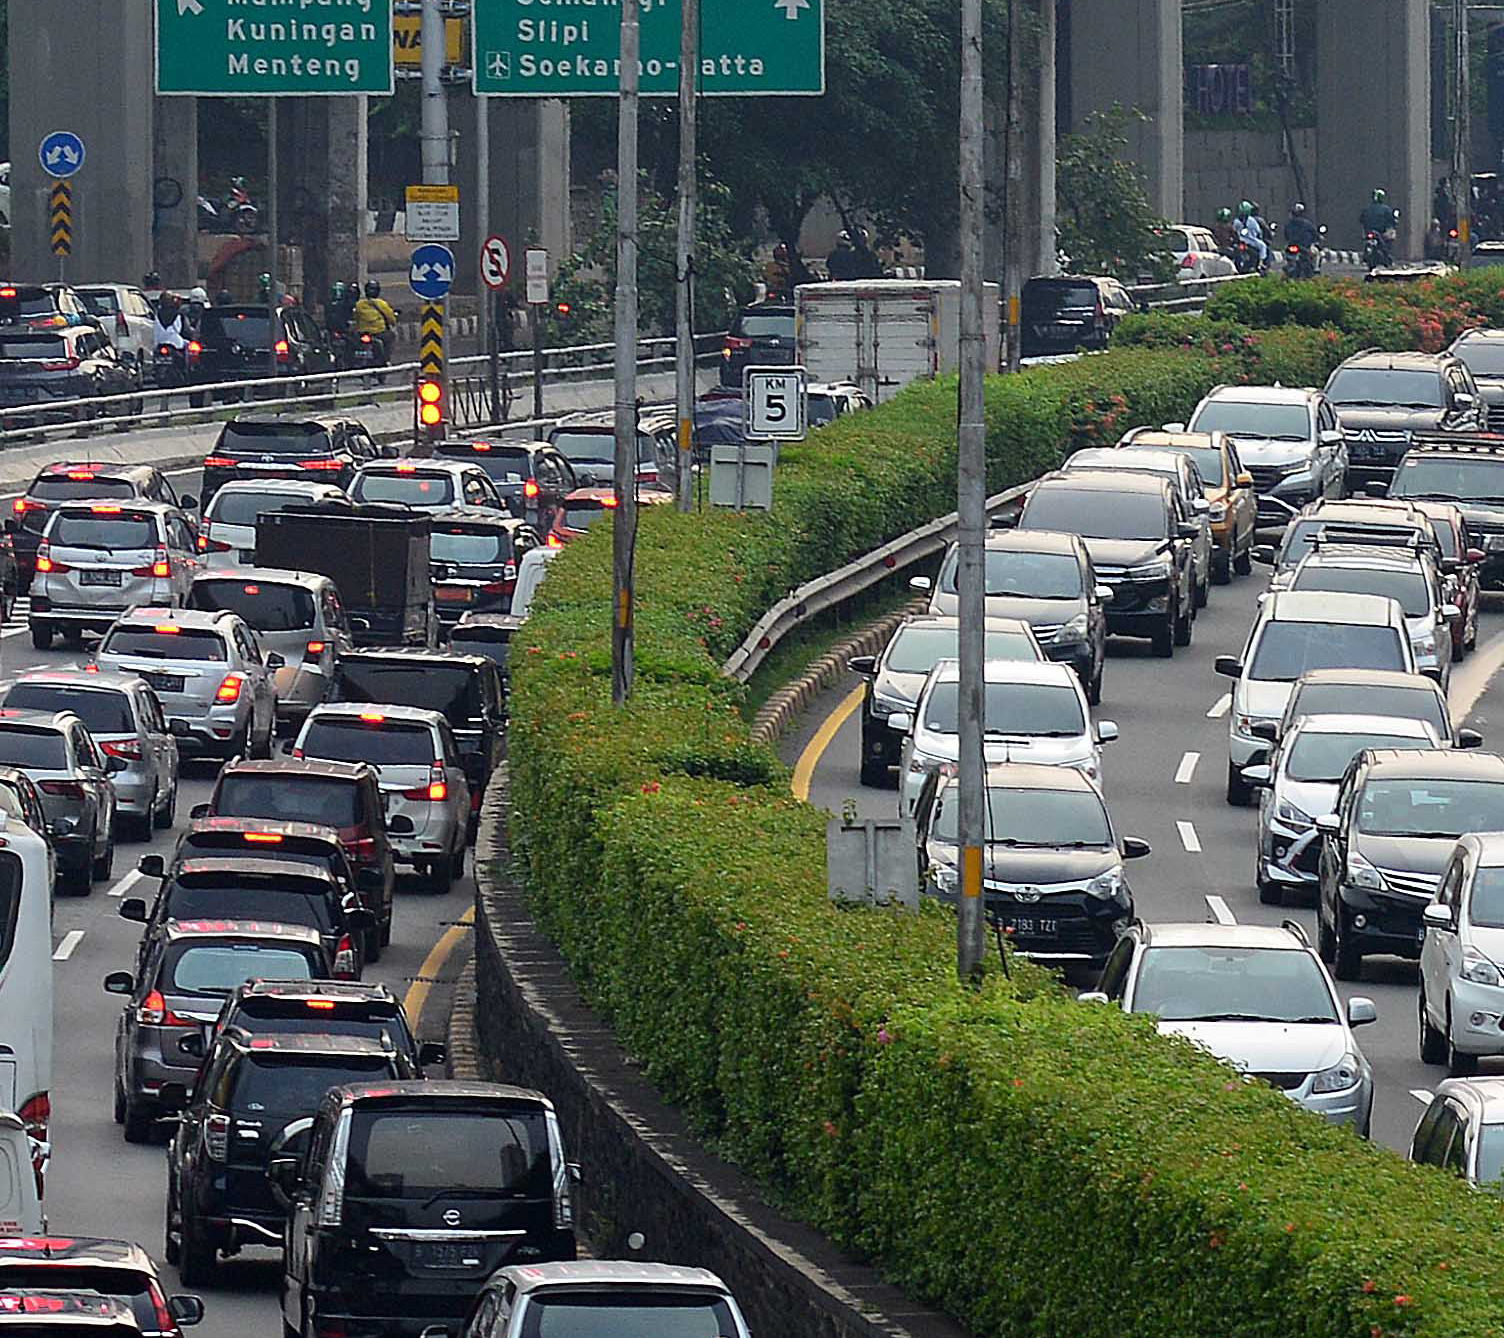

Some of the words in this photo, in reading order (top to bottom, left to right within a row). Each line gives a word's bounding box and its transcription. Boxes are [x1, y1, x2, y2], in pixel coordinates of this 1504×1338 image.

[227, 18, 376, 48] Kuningan
[517, 18, 589, 46] Slipi
[228, 53, 360, 82] Menteng
[519, 54, 765, 78] Soekaro-atta
[764, 378, 786, 390] KM
[765, 393, 787, 422] 5
